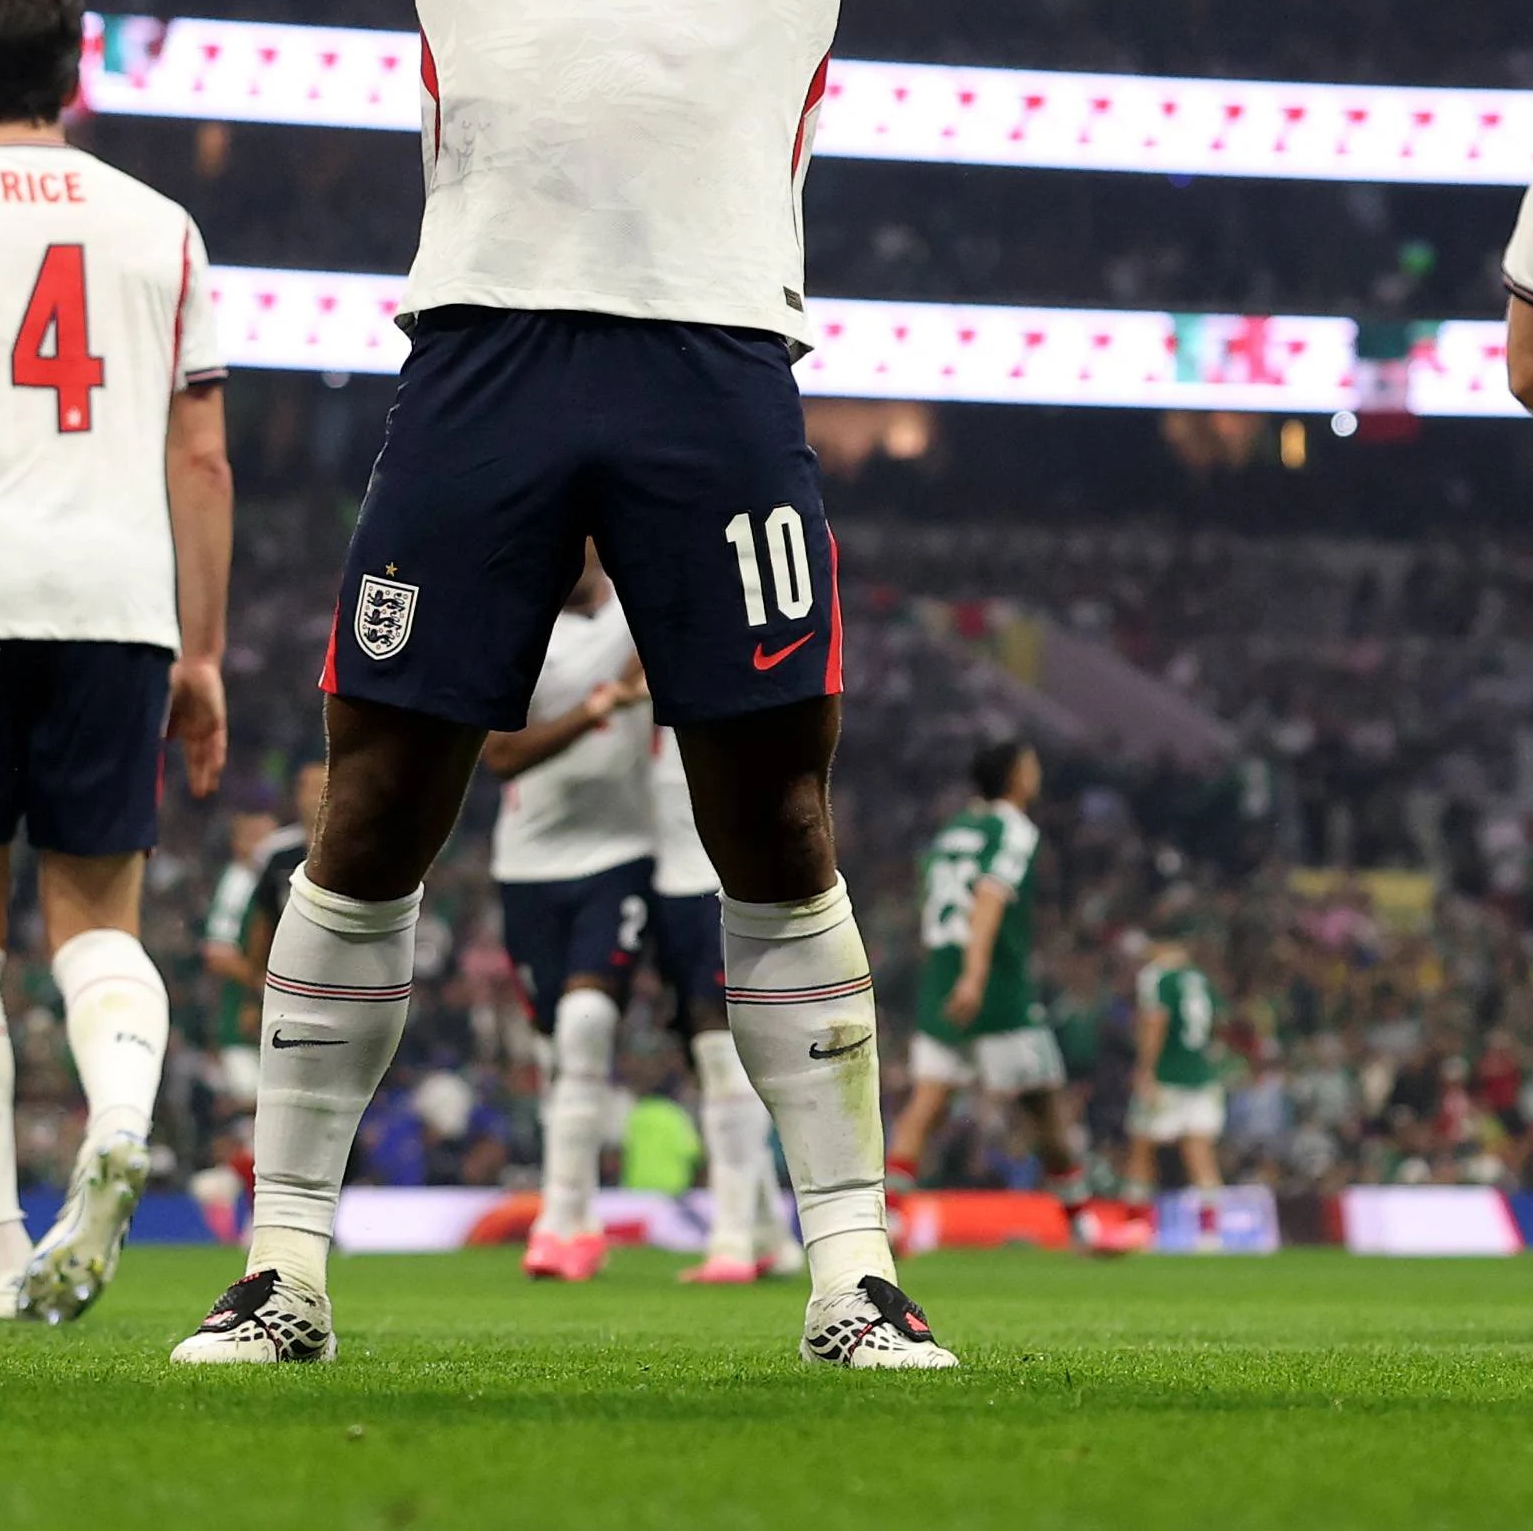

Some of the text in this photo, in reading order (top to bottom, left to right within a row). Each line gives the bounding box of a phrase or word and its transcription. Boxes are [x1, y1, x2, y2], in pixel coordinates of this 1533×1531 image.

[0, 170, 87, 204] RICE
[11, 243, 105, 433] 4
[725, 505, 813, 626] 10
[618, 893, 648, 951] 2
